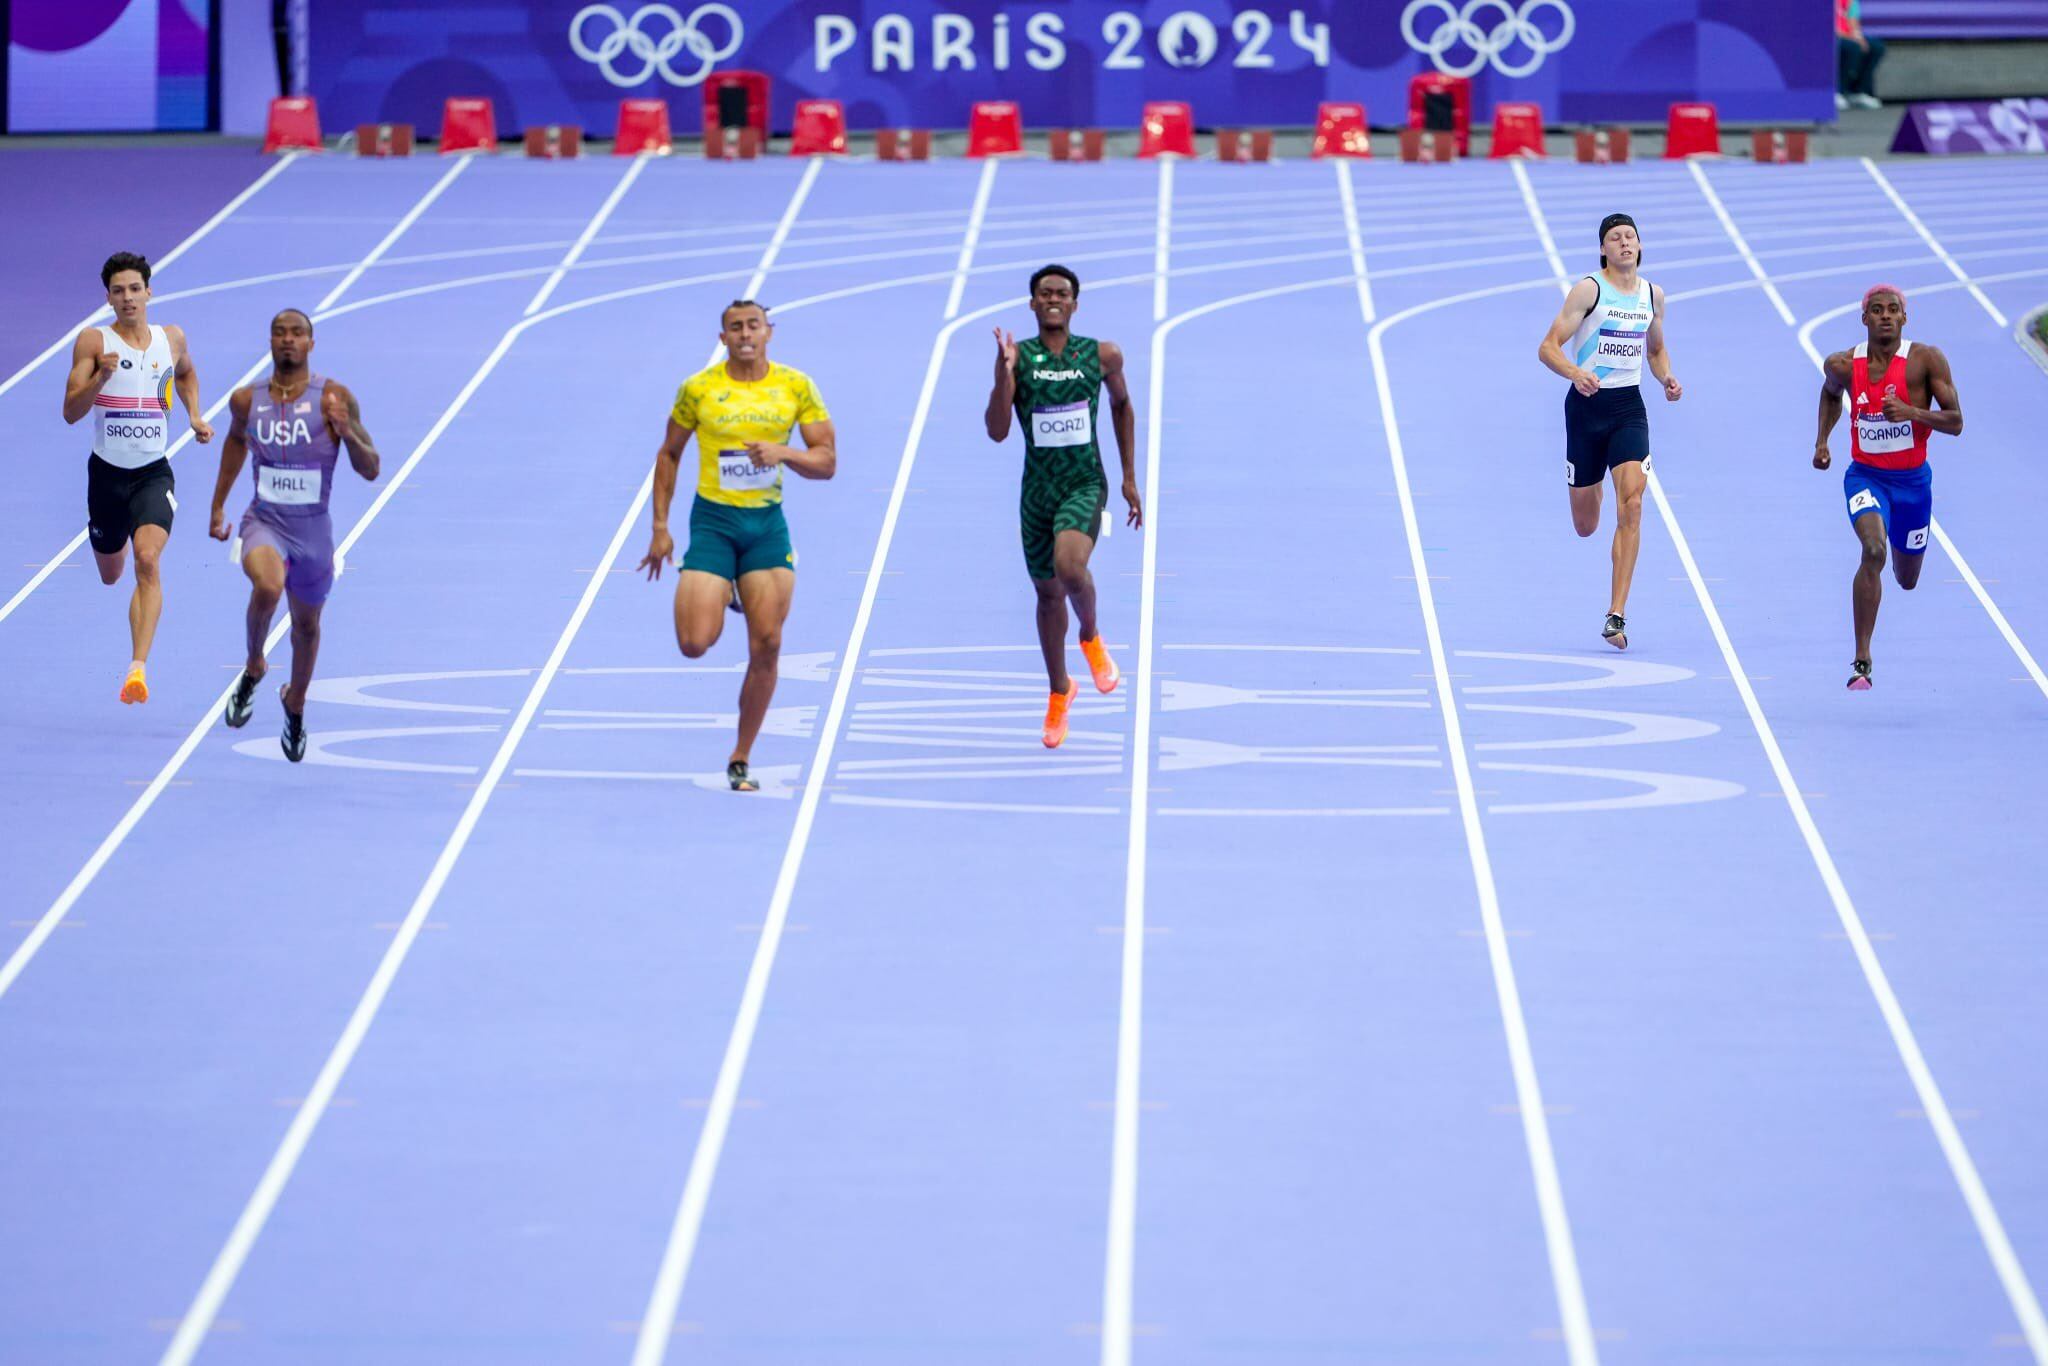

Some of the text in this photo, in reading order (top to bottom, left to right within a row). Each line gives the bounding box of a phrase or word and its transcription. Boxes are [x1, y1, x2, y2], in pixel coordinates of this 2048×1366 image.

[1102, 10, 1331, 69] 2024
[1607, 309, 1648, 320] ARGENTINA
[106, 424, 161, 438] SACOOR
[257, 418, 312, 446] USA
[1040, 417, 1085, 433] OGAZI
[1860, 424, 1911, 441] OGANDO
[272, 476, 306, 490] HALL
[1855, 495, 1866, 506] 2
[1914, 533, 1924, 545] 2
